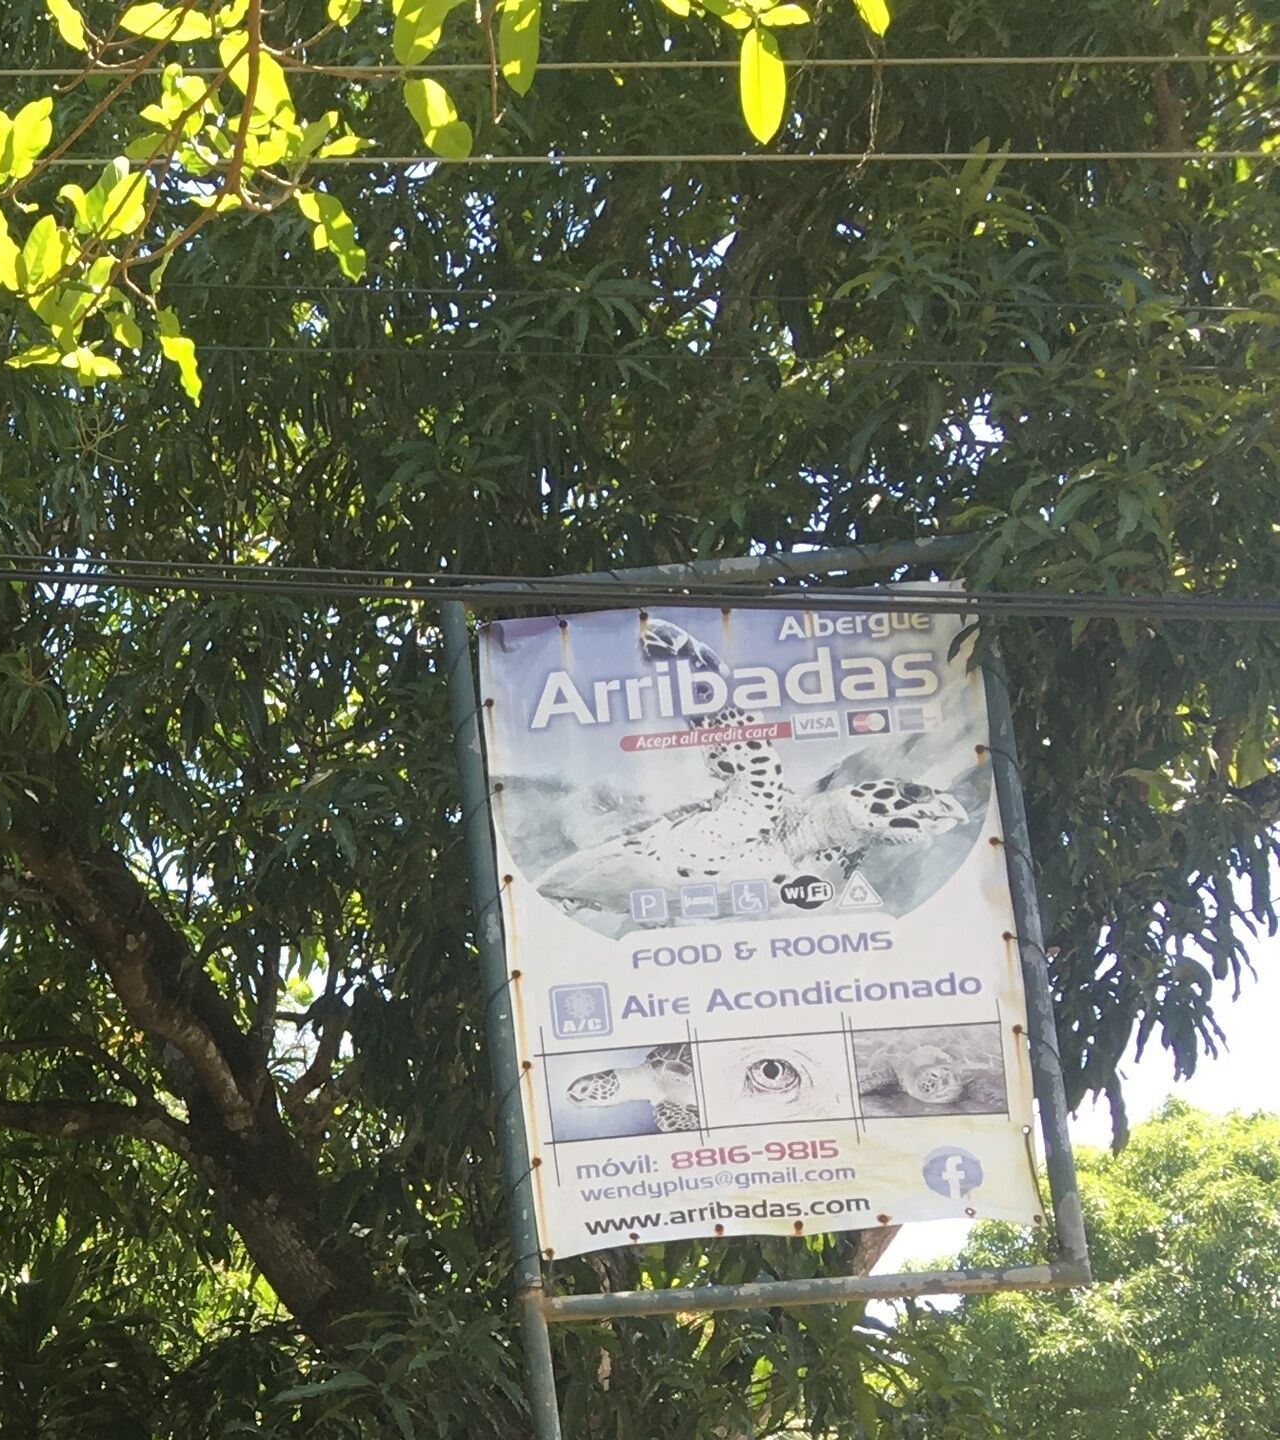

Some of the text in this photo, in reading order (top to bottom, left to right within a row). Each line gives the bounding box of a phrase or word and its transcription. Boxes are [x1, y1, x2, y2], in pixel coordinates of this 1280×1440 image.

[778, 612, 931, 641] Albergue
[530, 646, 939, 729] Arribadas
[636, 725, 778, 749] Acept all credit card
[798, 717, 835, 732] VISA
[632, 931, 894, 969] FOOD & ROOMS
[621, 972, 982, 1020] Aire Acondicionado
[562, 1017, 603, 1033] A/C
[576, 1139, 840, 1181] móvil: 8816-9815
[580, 1165, 856, 1203] wendyplus@gmail.com
[585, 1198, 871, 1236] www.arribadas.com
